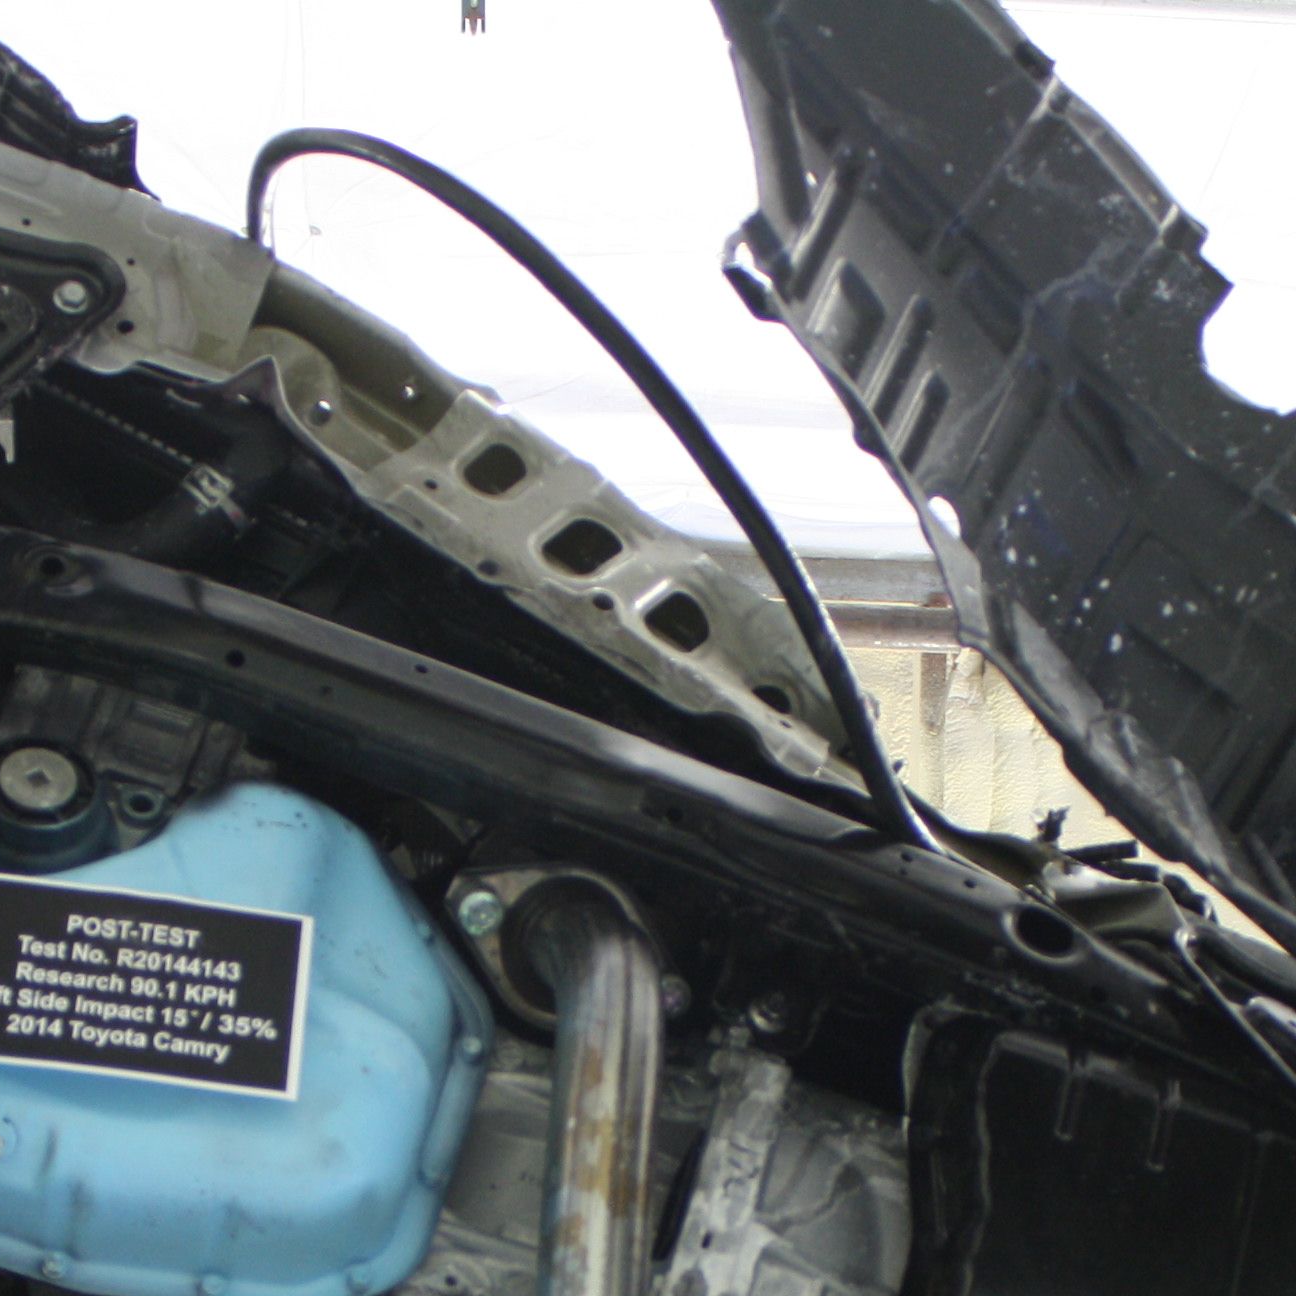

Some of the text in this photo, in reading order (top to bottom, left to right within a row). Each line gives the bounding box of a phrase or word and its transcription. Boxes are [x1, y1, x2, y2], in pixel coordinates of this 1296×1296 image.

[66, 914, 202, 950] POST-TEST
[17, 934, 243, 982] Test No. R20144143
[15, 961, 238, 1008] Research 90.1 KPH
[16, 987, 71, 1013] Side
[74, 994, 155, 1023] Impact
[217, 1013, 279, 1041] 35%
[5, 1013, 232, 1065] 2014 Toyota Camry
